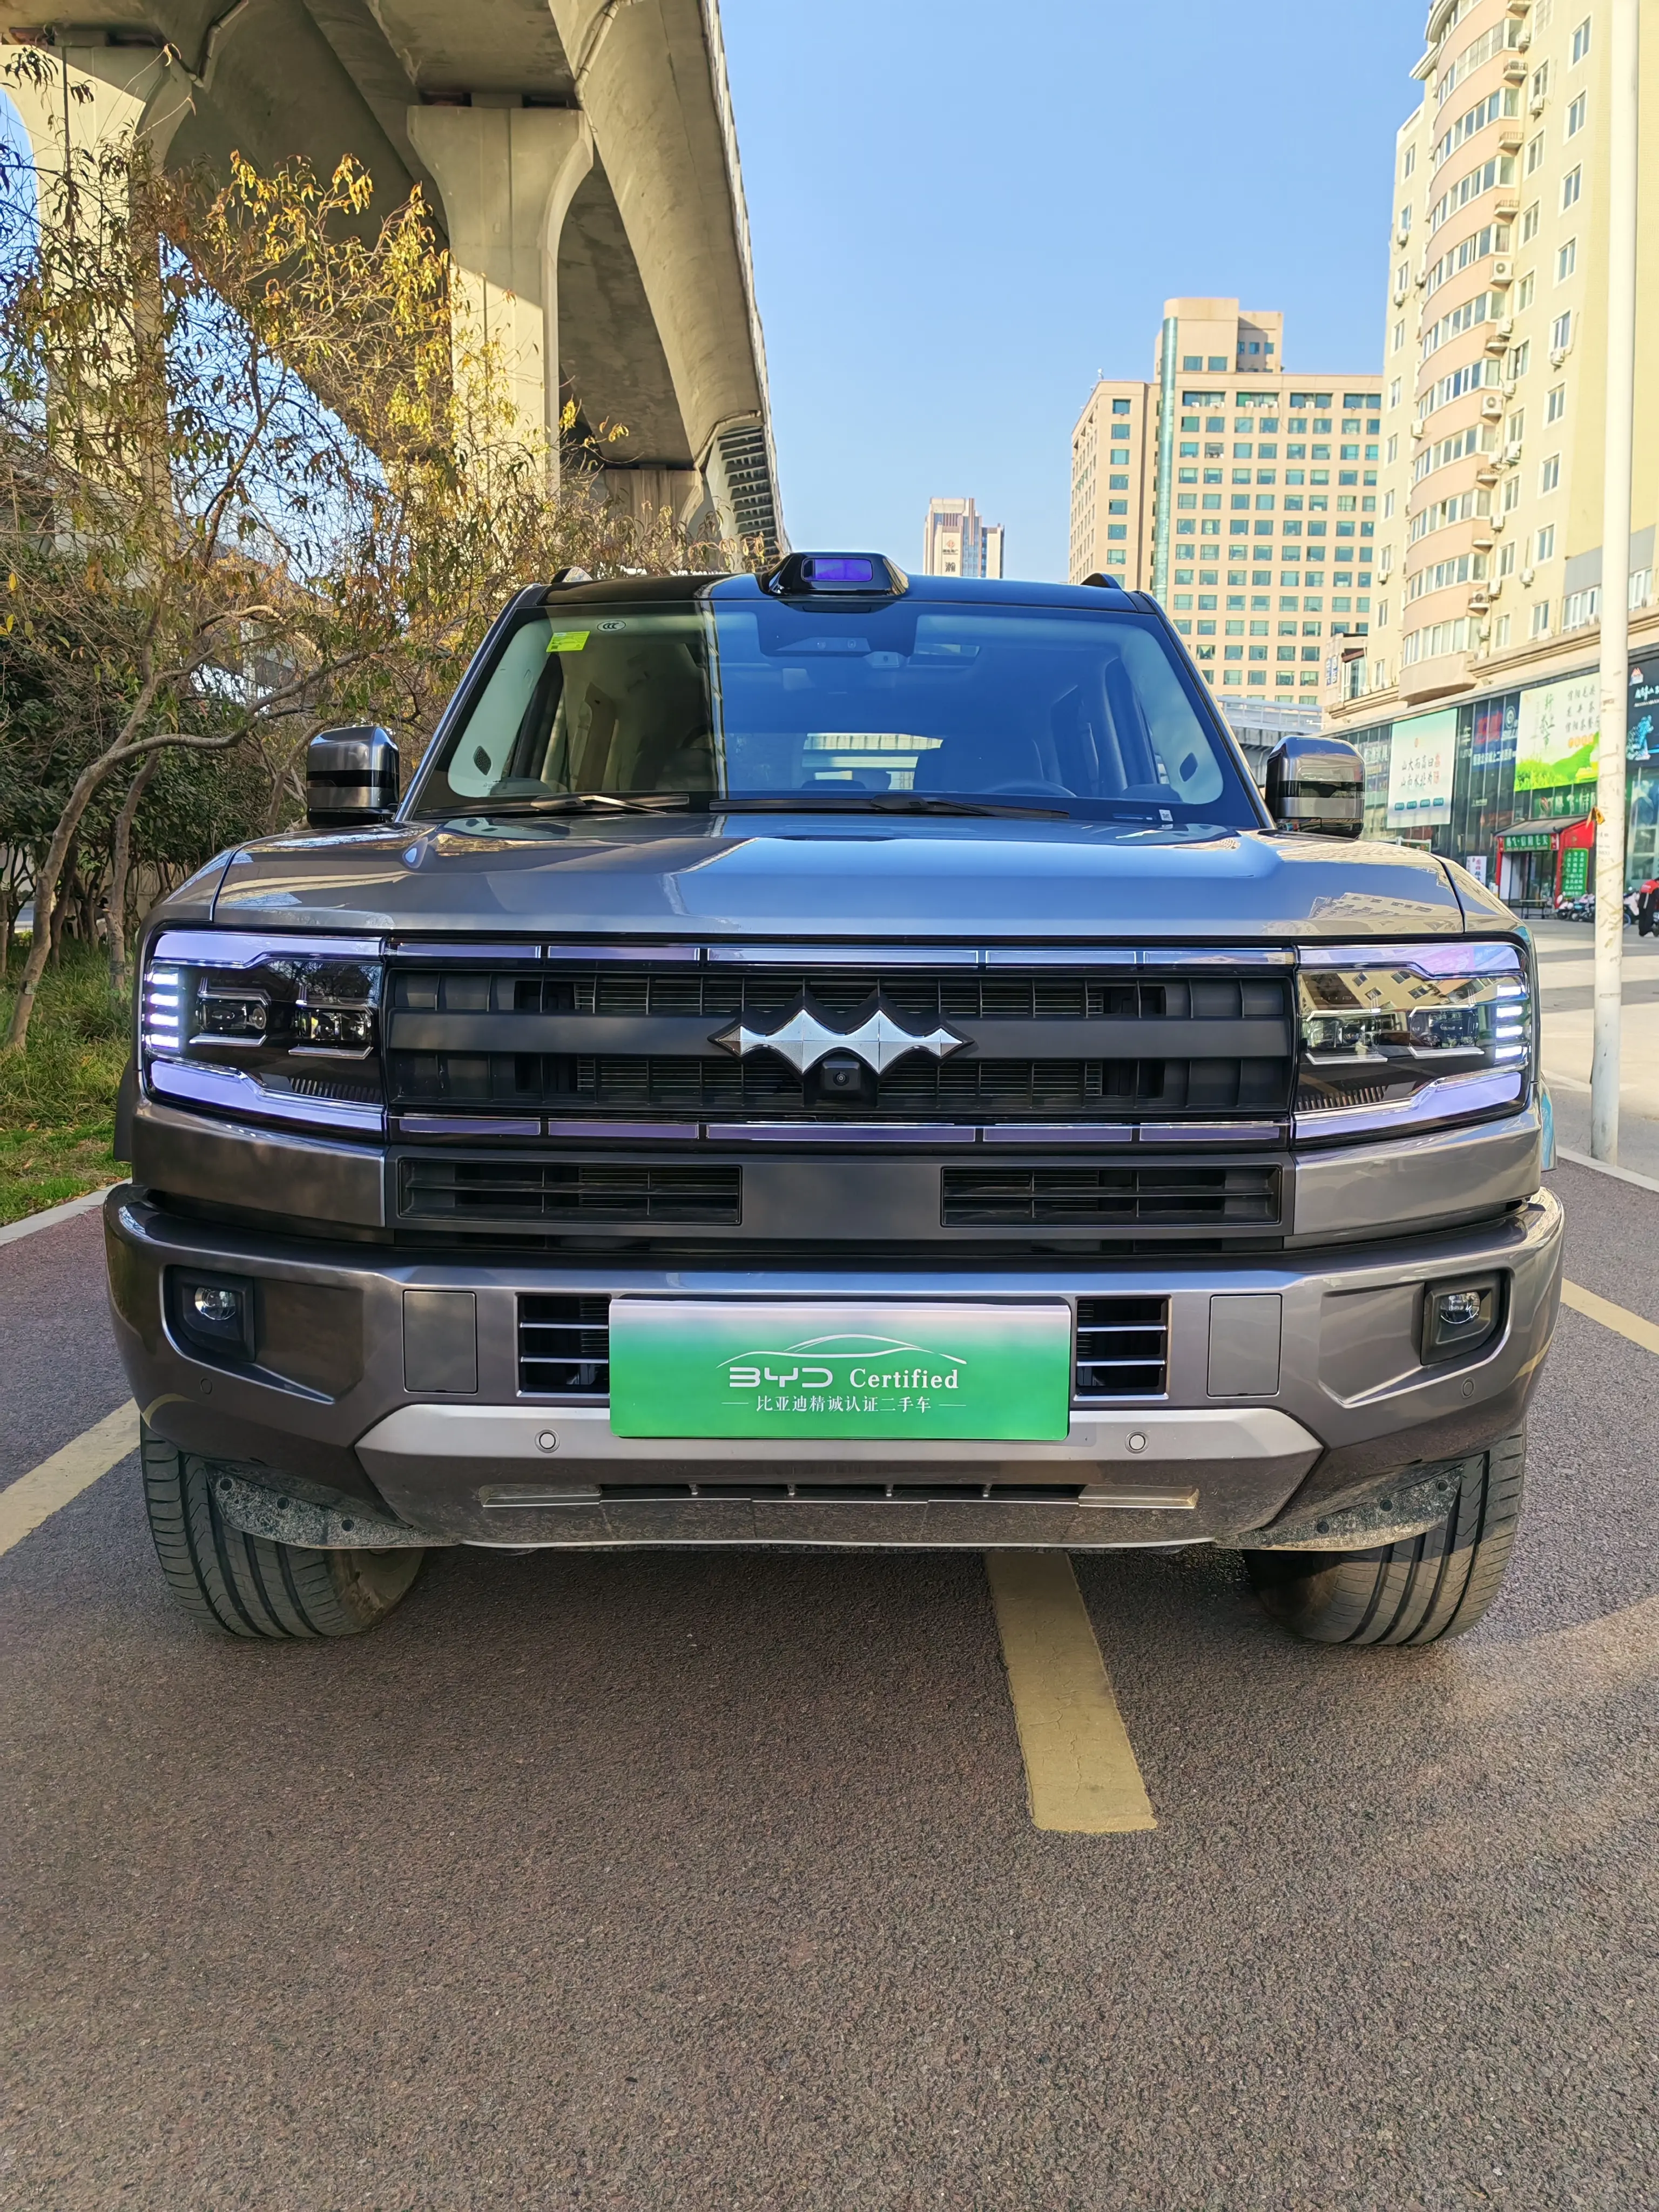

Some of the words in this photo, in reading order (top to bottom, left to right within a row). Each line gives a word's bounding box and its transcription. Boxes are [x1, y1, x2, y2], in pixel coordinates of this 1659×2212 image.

[730, 1367, 833, 1387] BYD
[849, 1368, 959, 1388] Certified
[756, 1395, 932, 1413] 比亚迪精诚认证二手车
